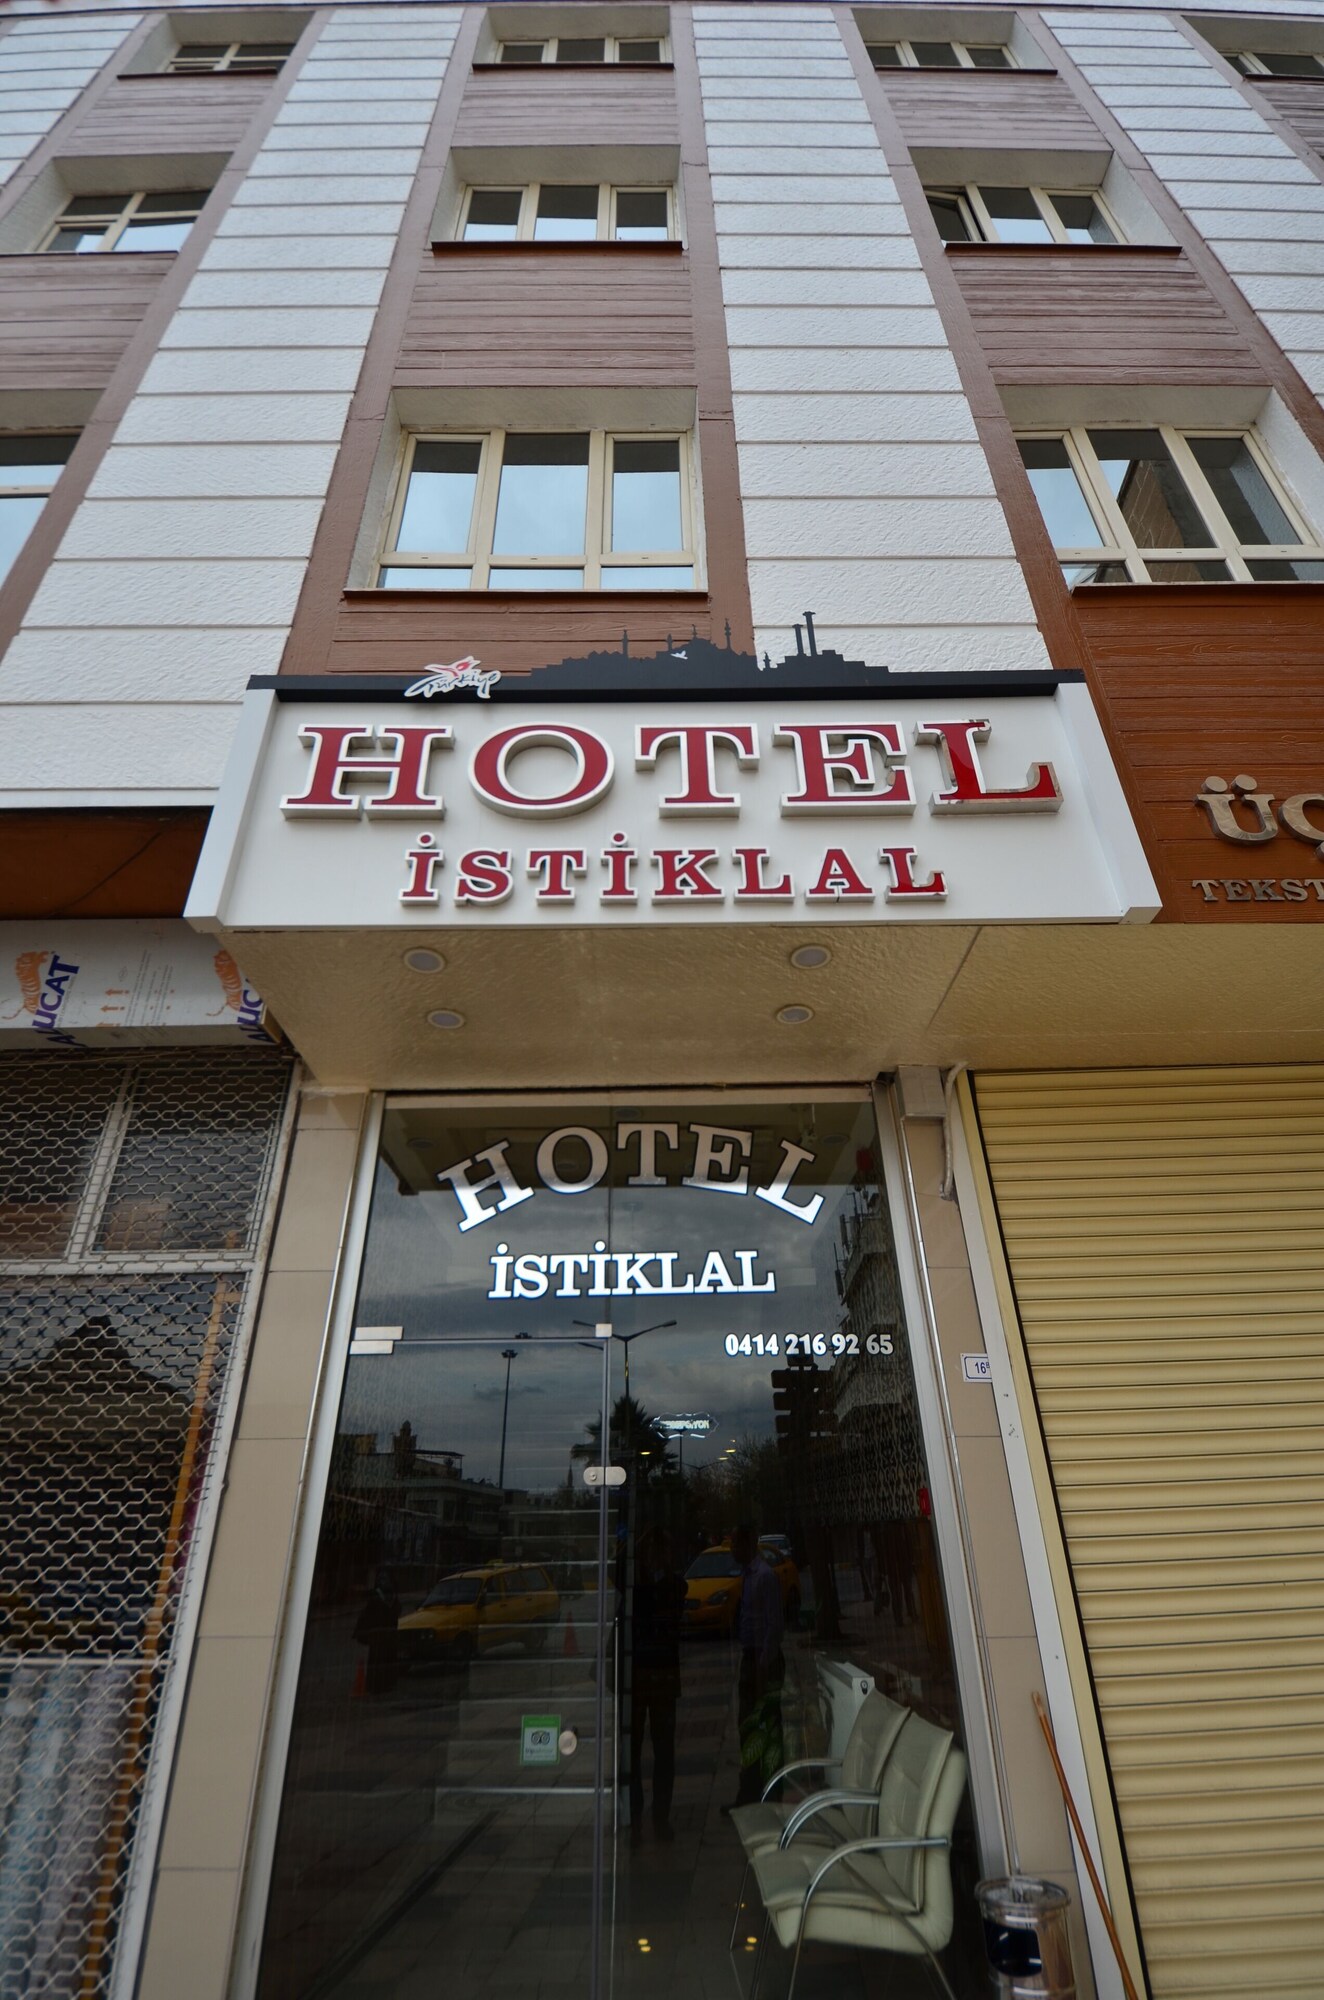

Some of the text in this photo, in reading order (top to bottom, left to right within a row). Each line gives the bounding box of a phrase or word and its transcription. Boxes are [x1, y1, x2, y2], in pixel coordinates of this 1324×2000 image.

[279, 719, 1064, 820] HOTEL
[398, 831, 949, 907] İSTİKLAL
[437, 1121, 825, 1233] HOTEL
[487, 1239, 777, 1300] İSTİKLAL
[724, 1332, 895, 1357] 0414 216 92 65
